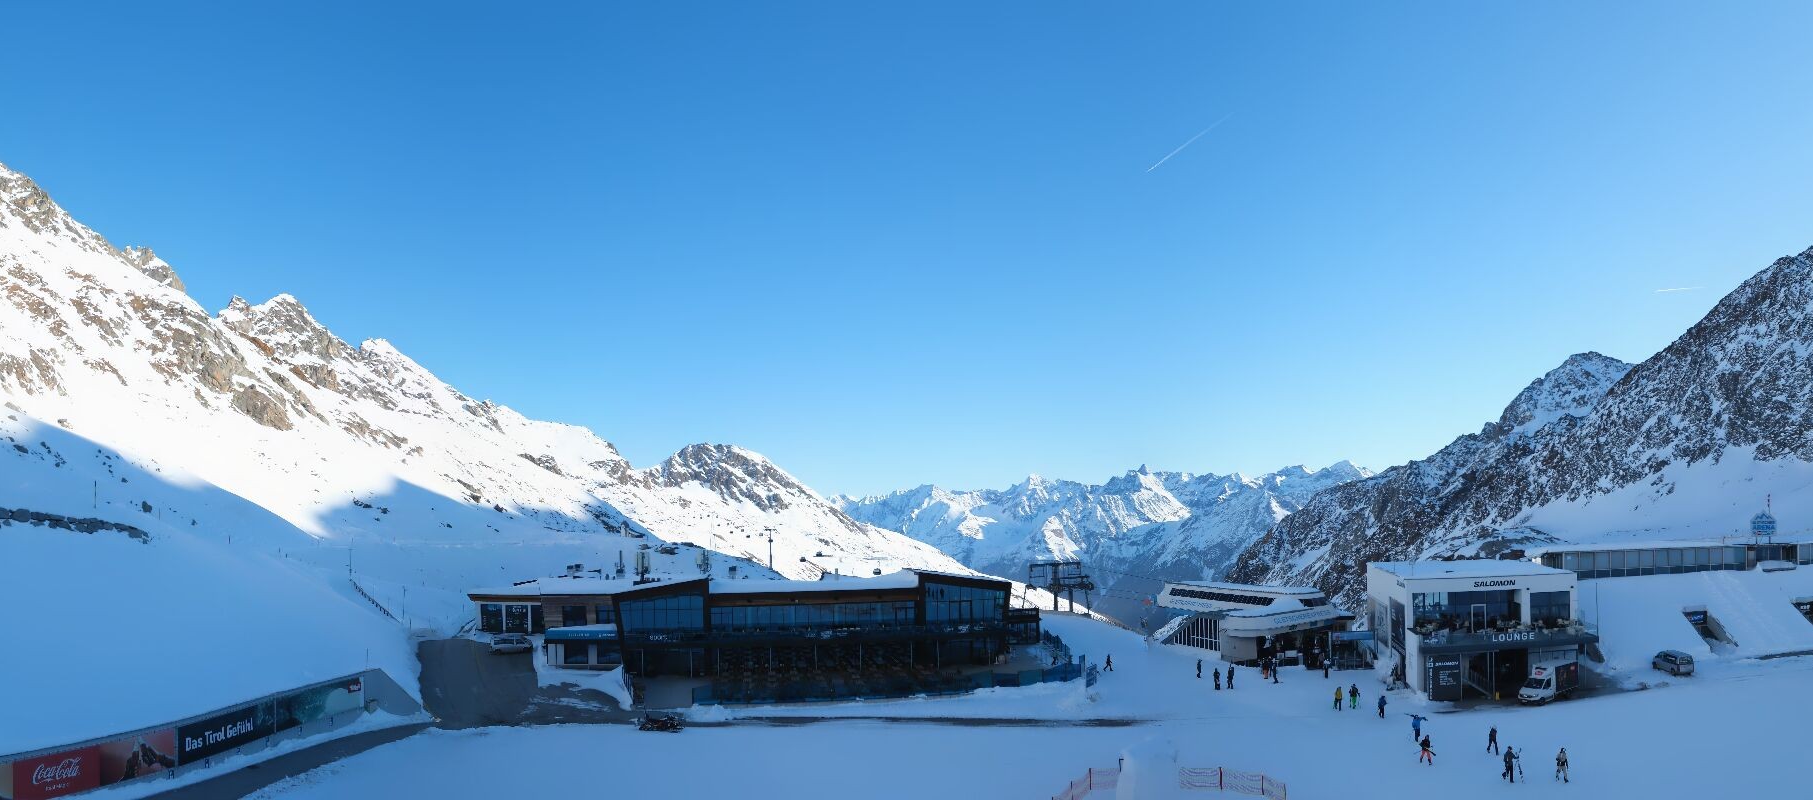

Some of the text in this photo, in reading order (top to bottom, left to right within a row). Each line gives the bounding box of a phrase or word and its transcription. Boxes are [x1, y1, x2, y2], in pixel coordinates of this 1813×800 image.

[1473, 579, 1516, 588] SALOMON
[1492, 632, 1535, 642] LOUNGE
[185, 717, 254, 752] Das Tirol Gefühl
[31, 756, 82, 785] Coca-Cola
